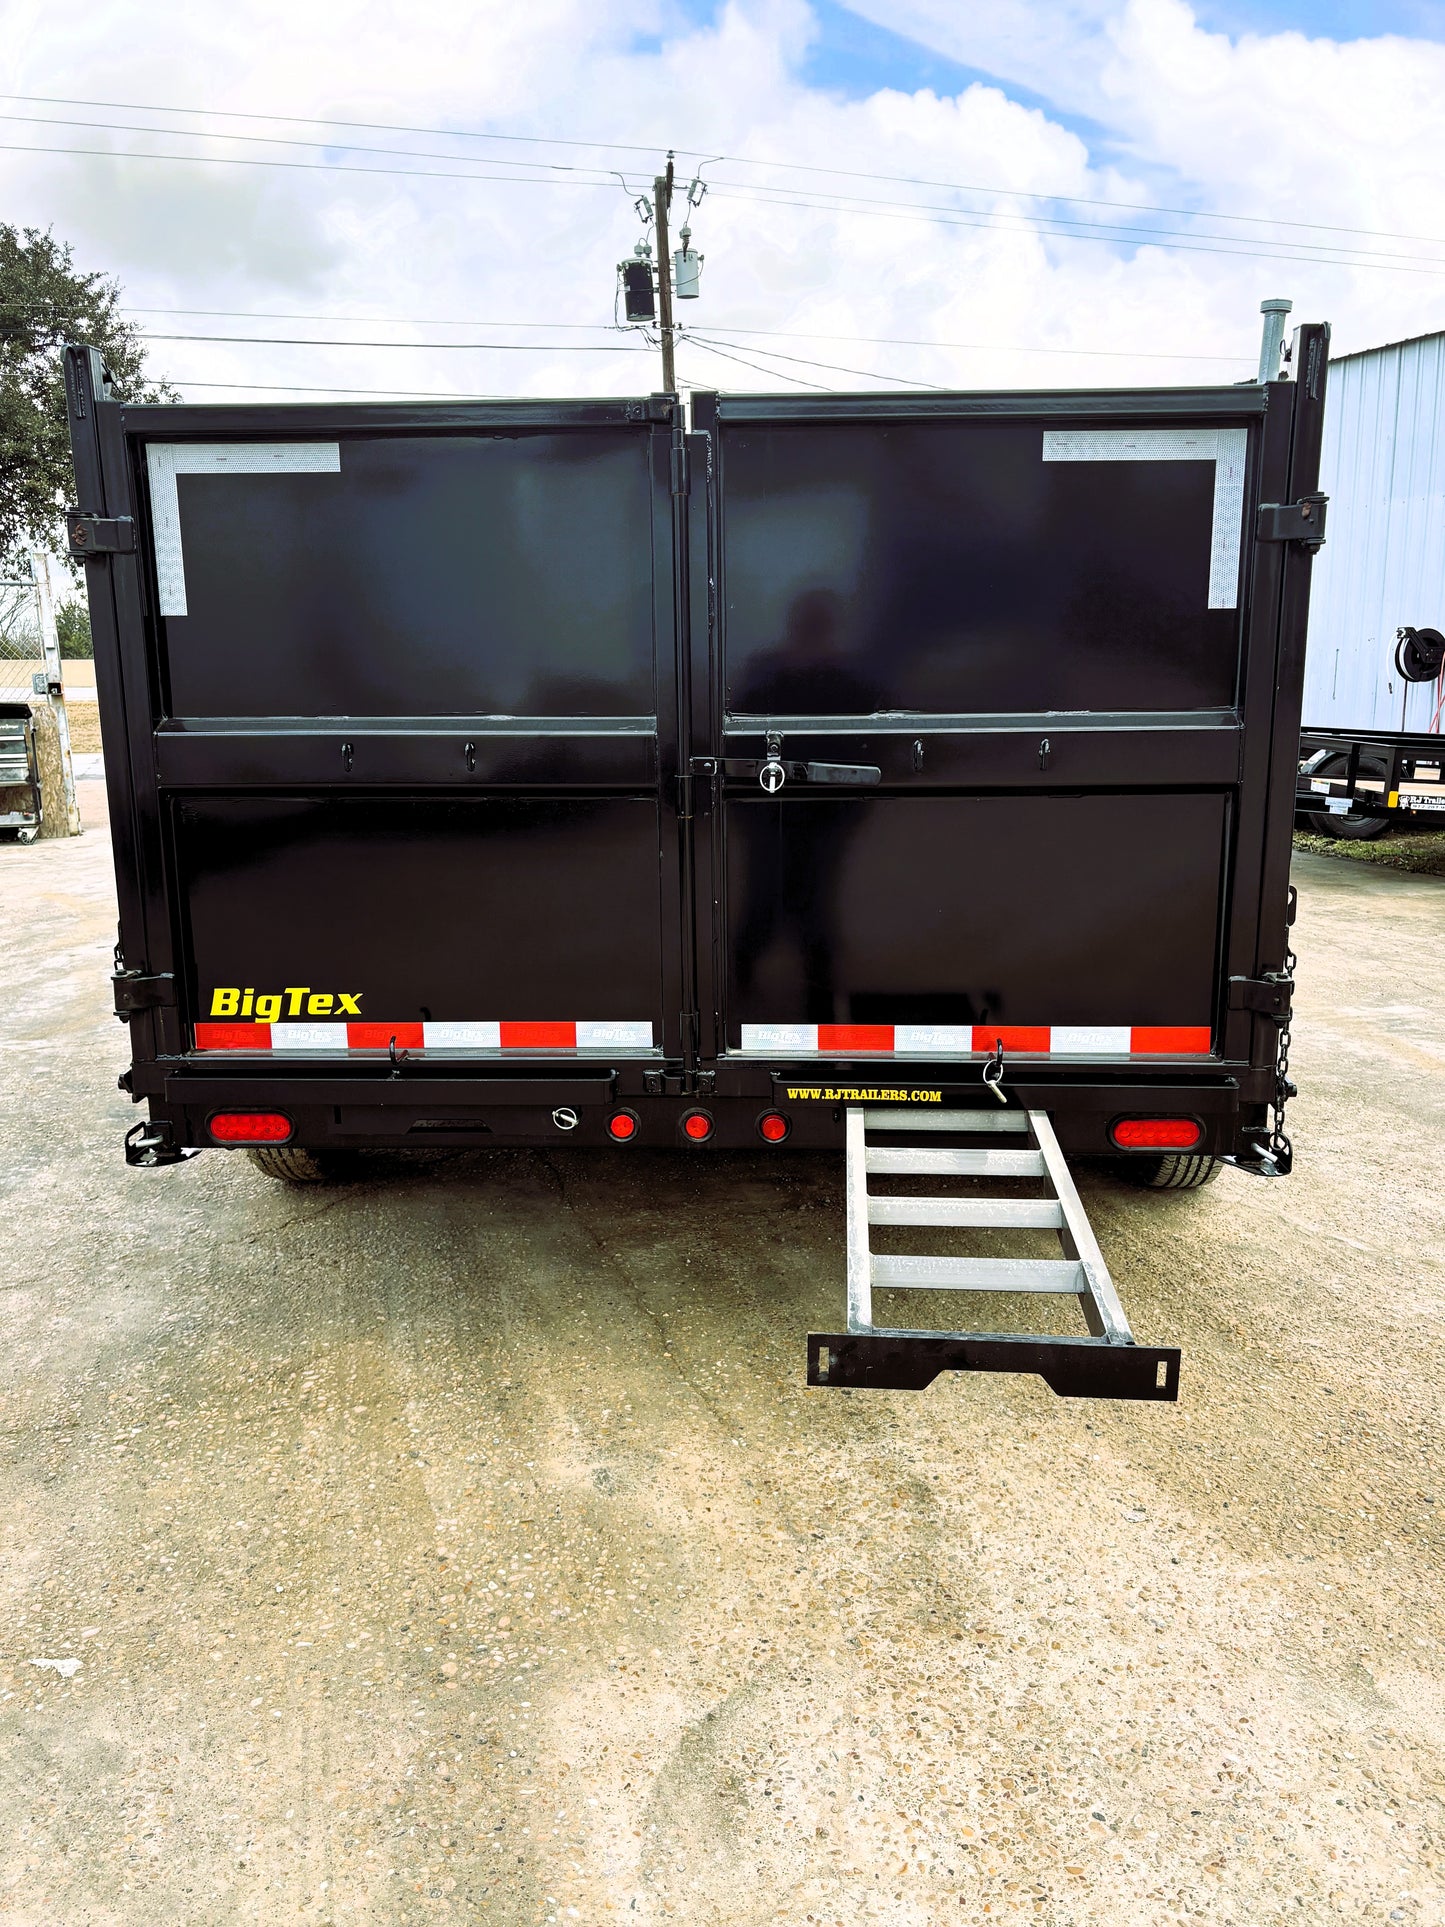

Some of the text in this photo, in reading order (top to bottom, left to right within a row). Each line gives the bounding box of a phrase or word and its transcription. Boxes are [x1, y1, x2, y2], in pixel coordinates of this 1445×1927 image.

[210, 988, 363, 1023] BigTex
[288, 1030, 332, 1042] BigTex
[592, 1029, 637, 1041] BigTex
[758, 1031, 802, 1043] BigTex
[910, 1031, 955, 1043] BigTex
[787, 1088, 942, 1102] WWW.RJTRAILERS.COM
